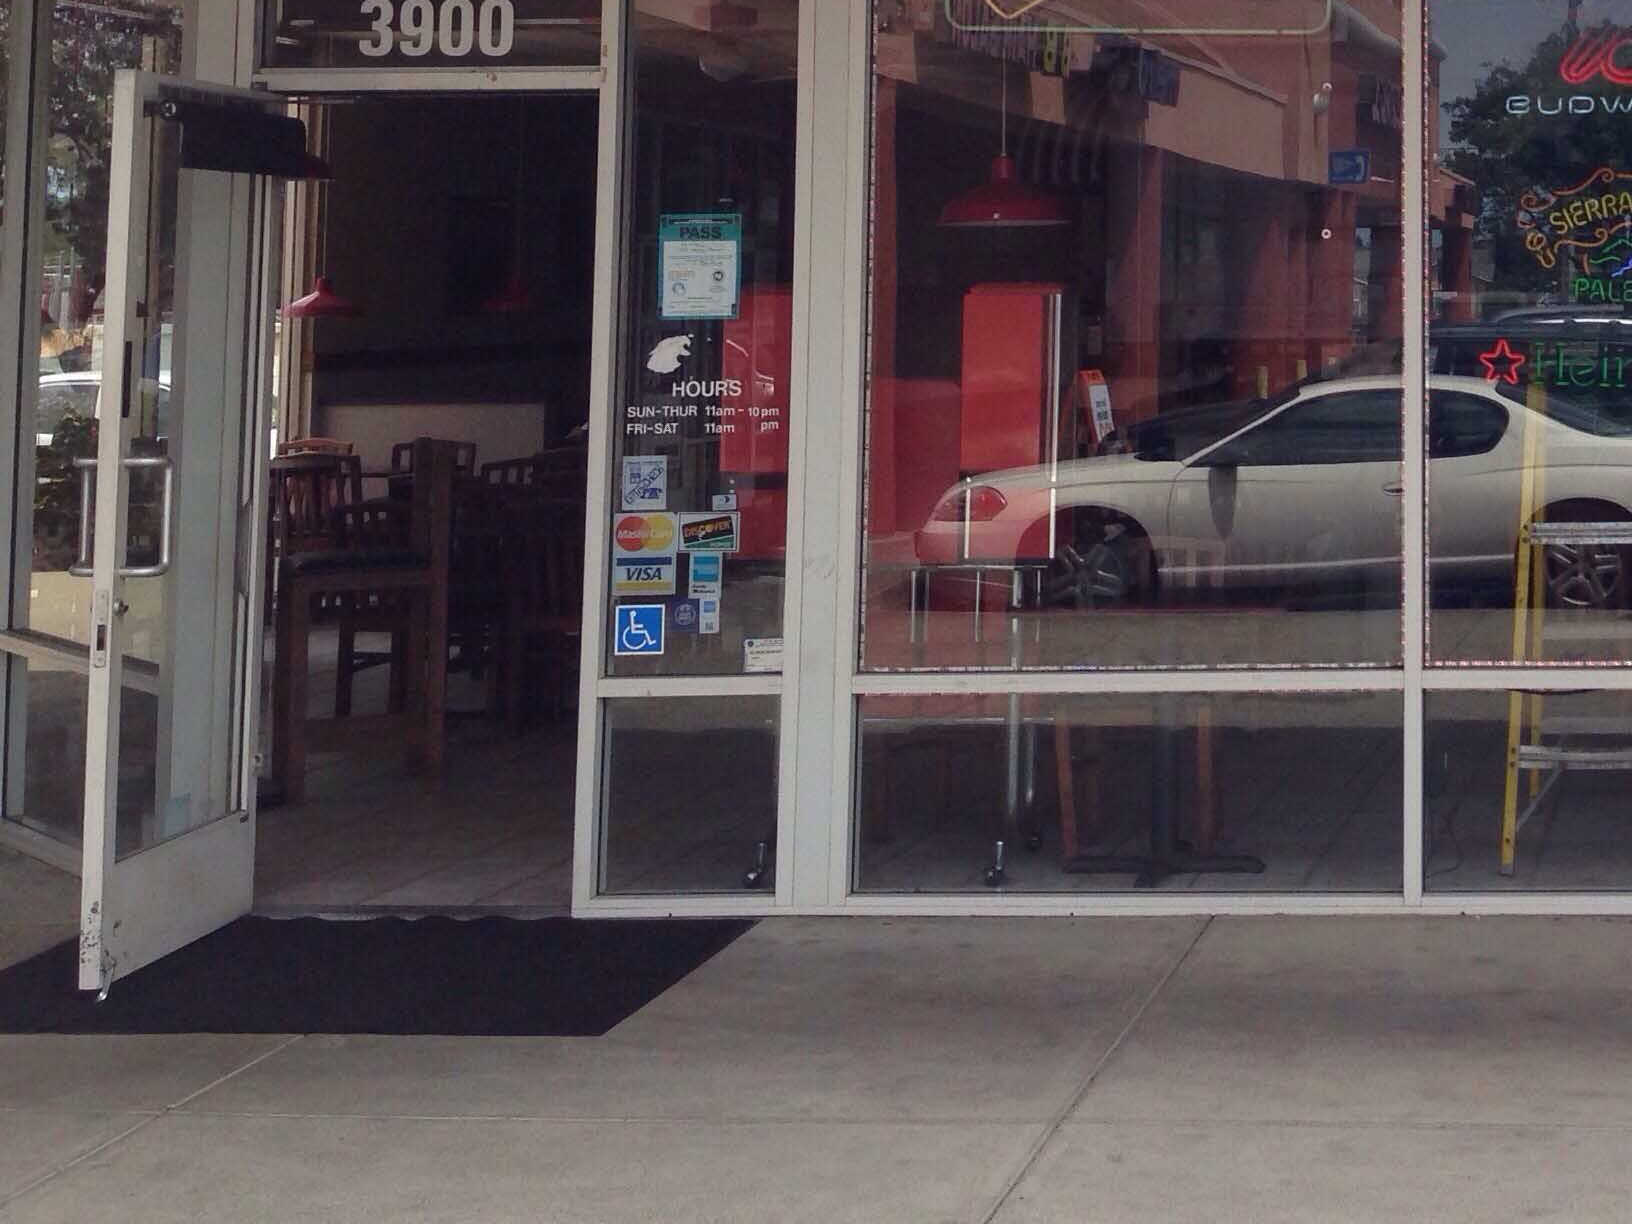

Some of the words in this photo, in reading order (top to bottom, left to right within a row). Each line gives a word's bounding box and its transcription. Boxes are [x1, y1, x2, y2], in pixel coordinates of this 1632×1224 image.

[679, 226, 722, 239] PASS
[672, 380, 742, 397] HOURS
[627, 405, 697, 418] SUN-THUR
[626, 422, 678, 435] FRI-SAT
[625, 567, 663, 581] VISA
